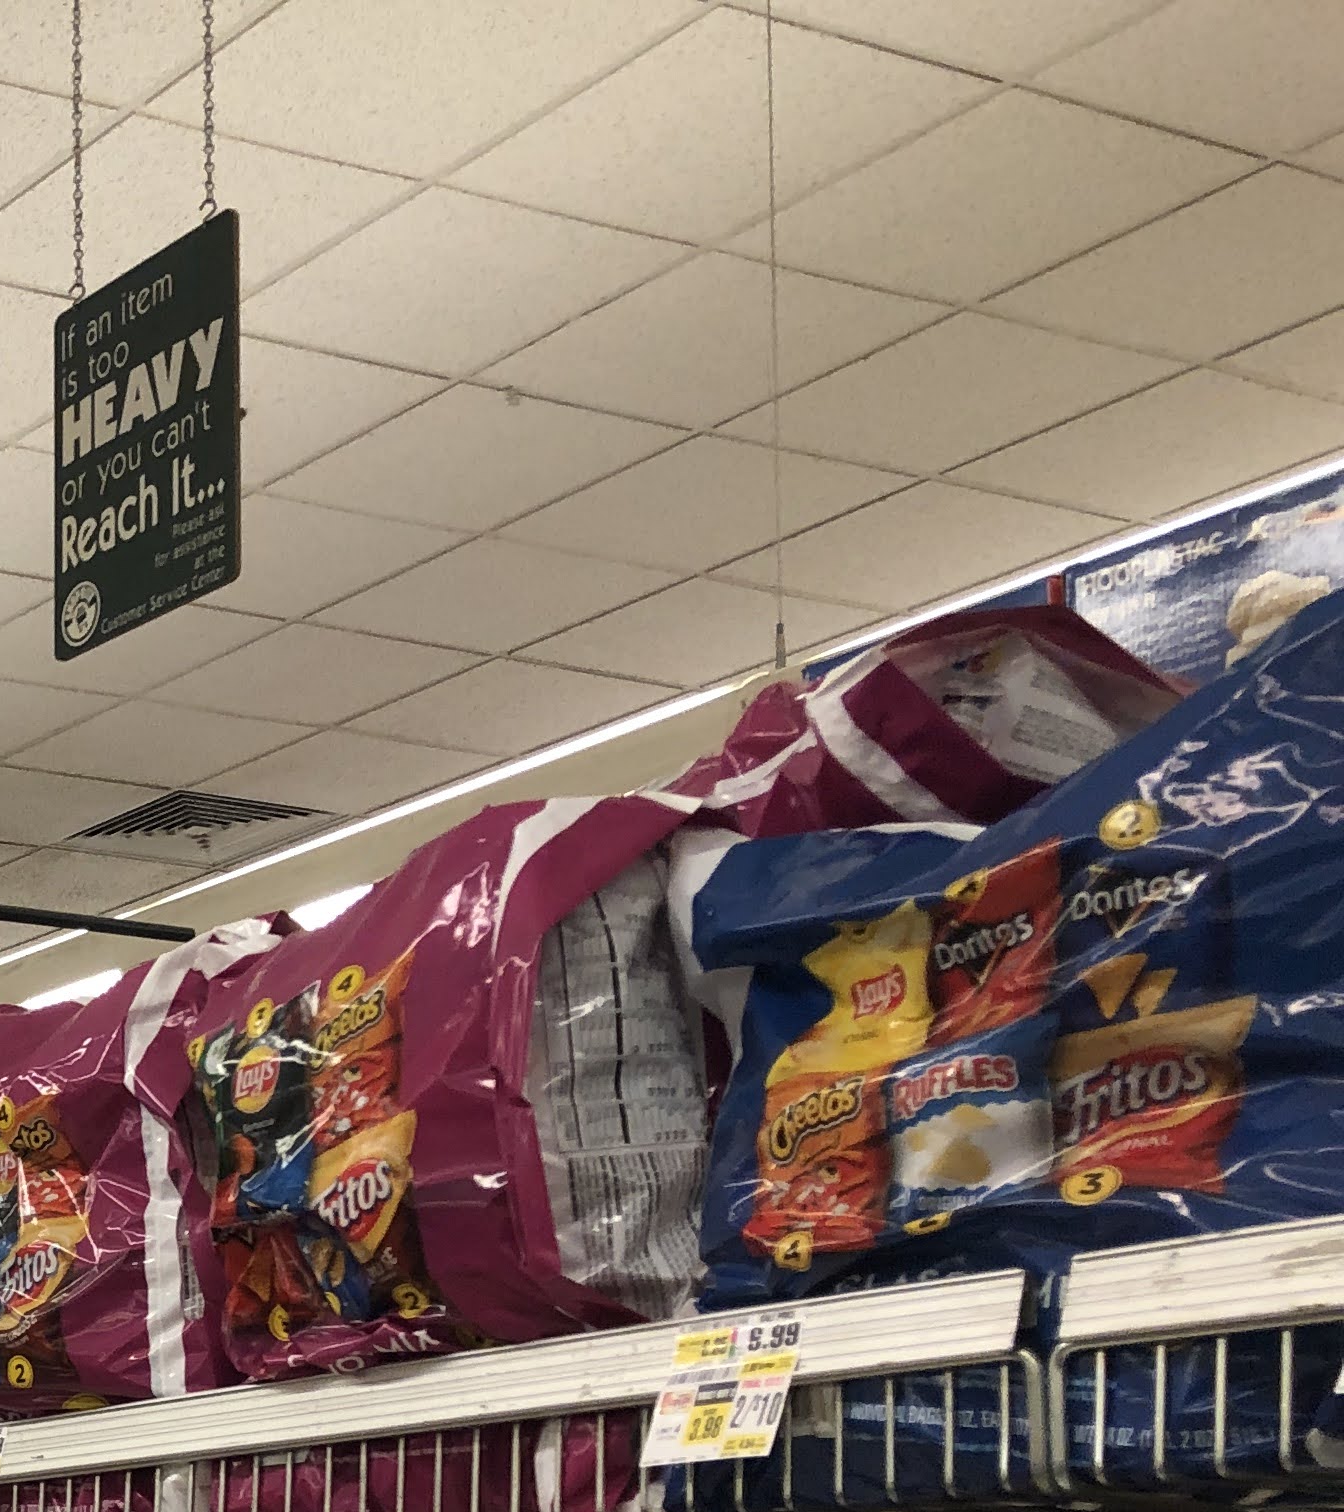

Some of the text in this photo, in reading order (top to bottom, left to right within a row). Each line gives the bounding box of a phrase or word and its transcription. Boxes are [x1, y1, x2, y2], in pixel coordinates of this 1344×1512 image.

[61, 273, 173, 363] If an item
[62, 340, 129, 400] is too
[62, 317, 224, 468] HEAVY
[62, 401, 212, 506] or you can't
[62, 474, 159, 574] Reach
[934, 911, 1034, 970] Doritos
[338, 972, 353, 995] 4
[769, 1076, 864, 1163] Cheetos
[1080, 1172, 1104, 1196] 3
[15, 1365, 25, 1382] 2
